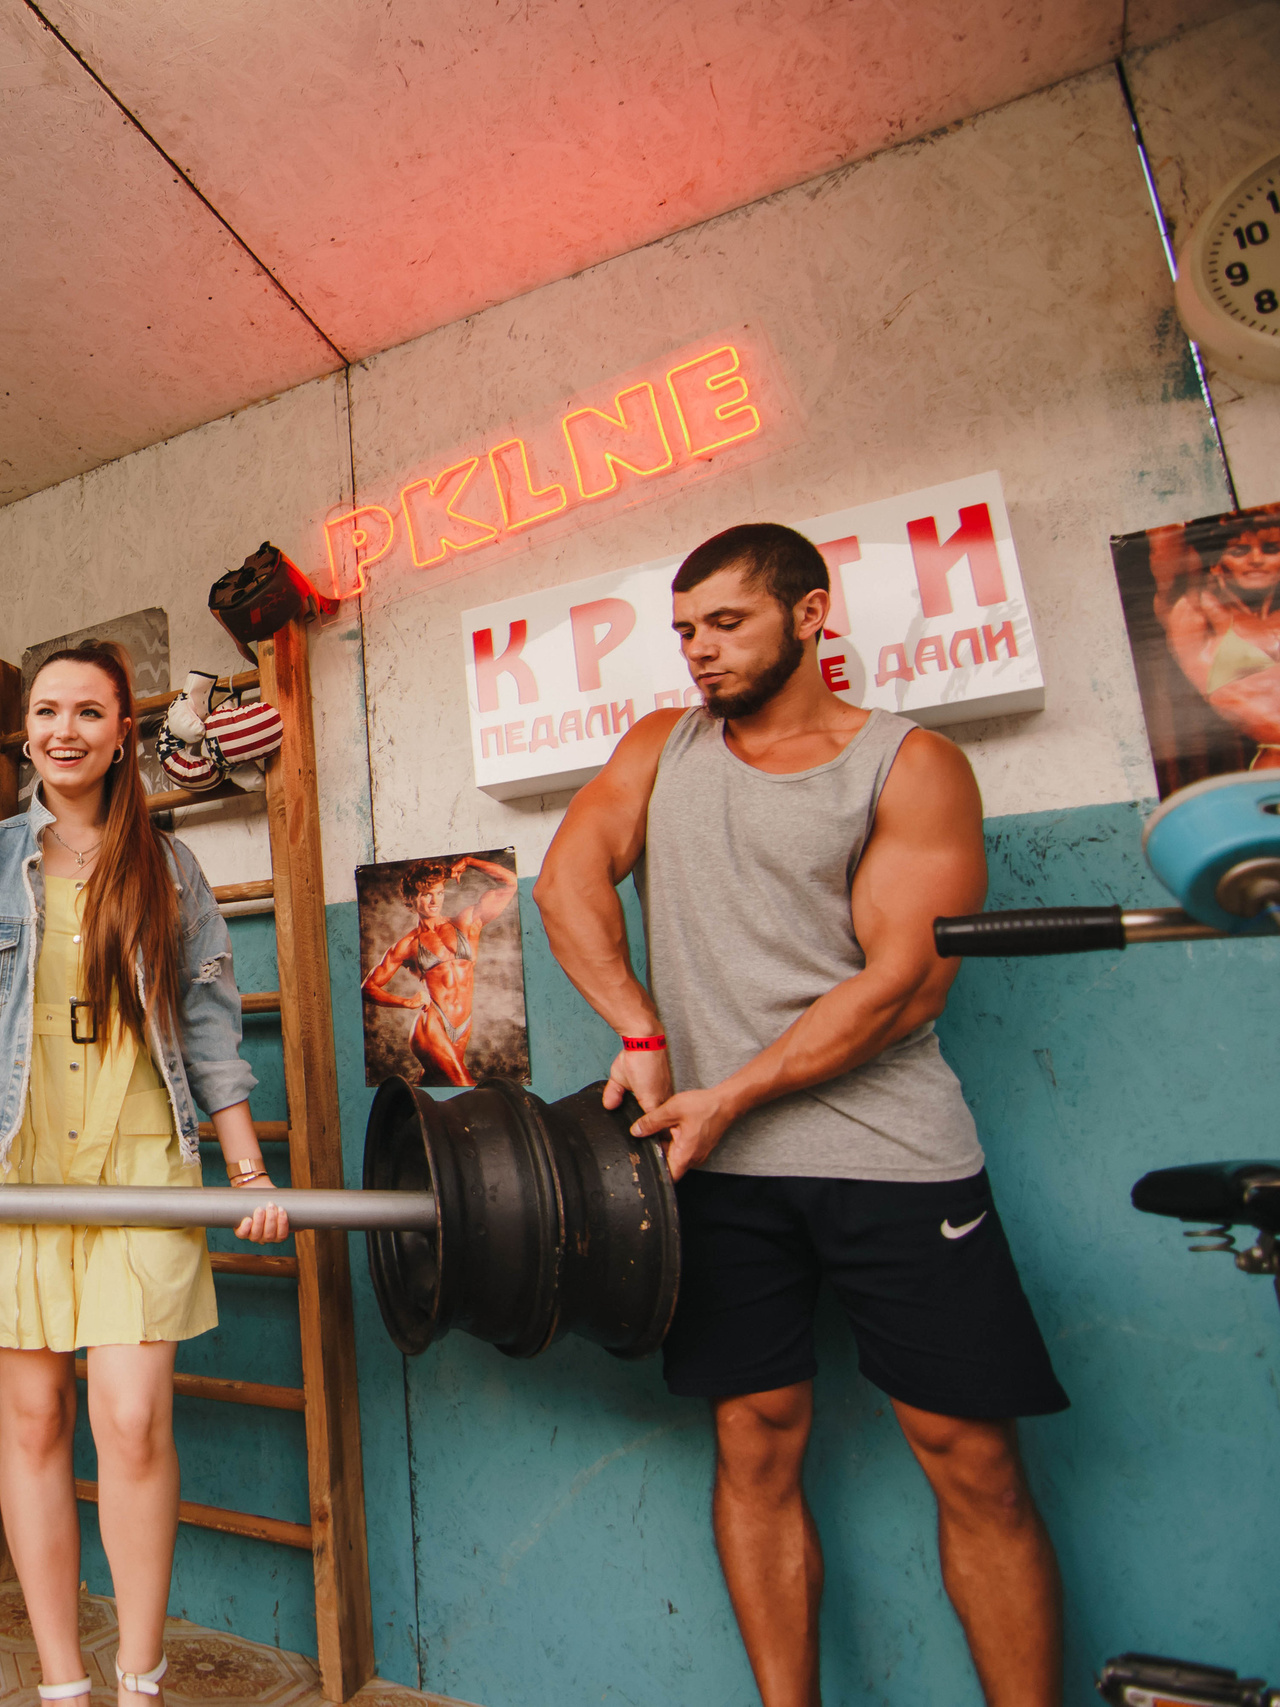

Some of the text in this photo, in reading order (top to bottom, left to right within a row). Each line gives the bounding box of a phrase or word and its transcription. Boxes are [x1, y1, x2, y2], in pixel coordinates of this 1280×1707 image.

[1233, 220, 1270, 249] 10
[1225, 261, 1249, 286] 9
[1254, 289, 1279, 314] 8
[324, 344, 761, 600] PKLNE
[472, 502, 1008, 713] КРТИ
[480, 698, 635, 759] ПЕДАЛИ
[820, 654, 851, 693] Е
[874, 620, 1018, 688] ДАЛИ
[625, 1040, 650, 1049] KLNE
